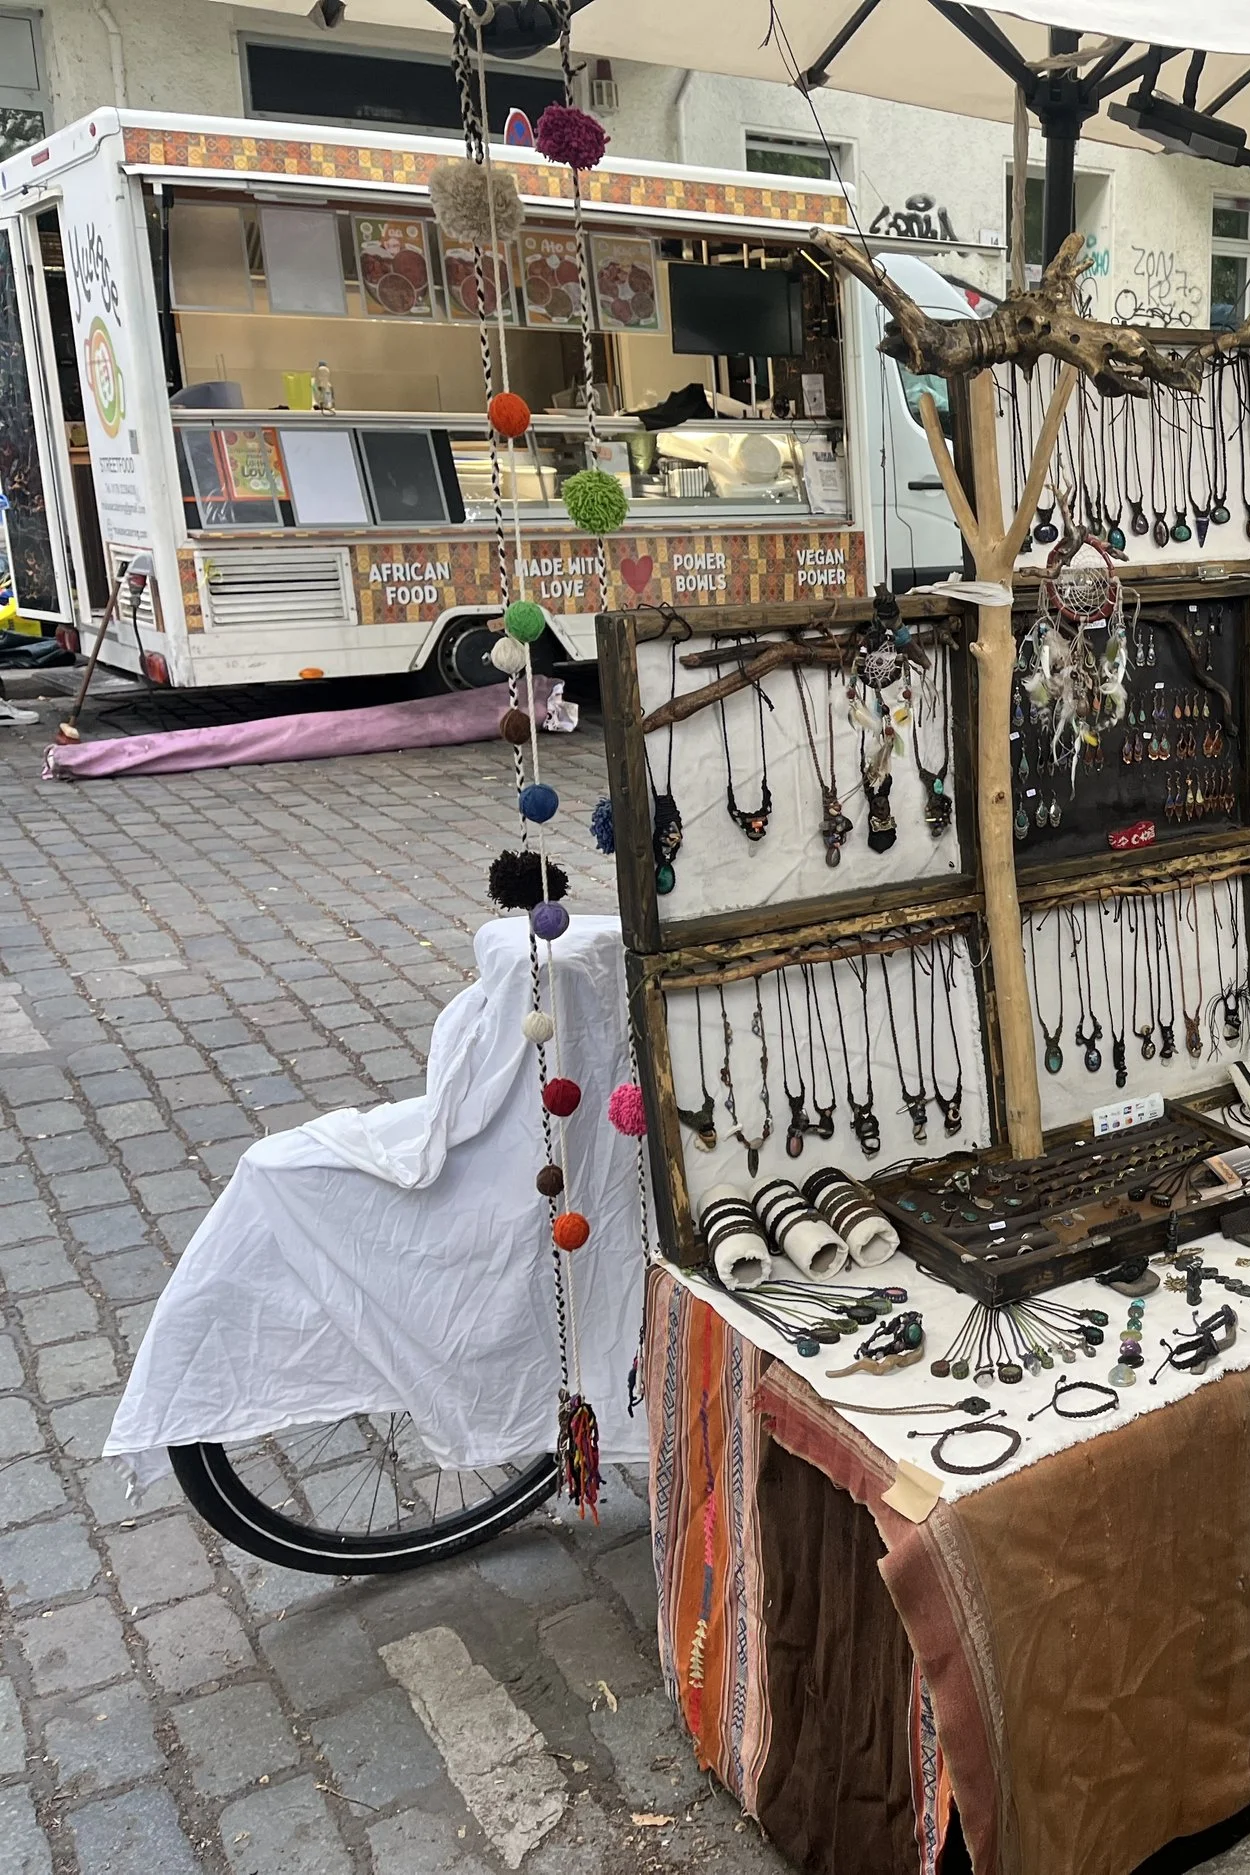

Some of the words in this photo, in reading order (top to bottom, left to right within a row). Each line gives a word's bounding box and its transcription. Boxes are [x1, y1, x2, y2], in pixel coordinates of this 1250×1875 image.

[241, 466, 273, 478] LOV
[514, 557, 564, 577] MADE
[673, 552, 727, 571] POWER
[796, 548, 845, 566] VEGAN
[368, 562, 450, 583] AFRICAN
[798, 568, 847, 586] POWER
[540, 579, 585, 599] LOVE
[675, 573, 728, 593] BOWLS
[386, 585, 438, 605] FOOD
